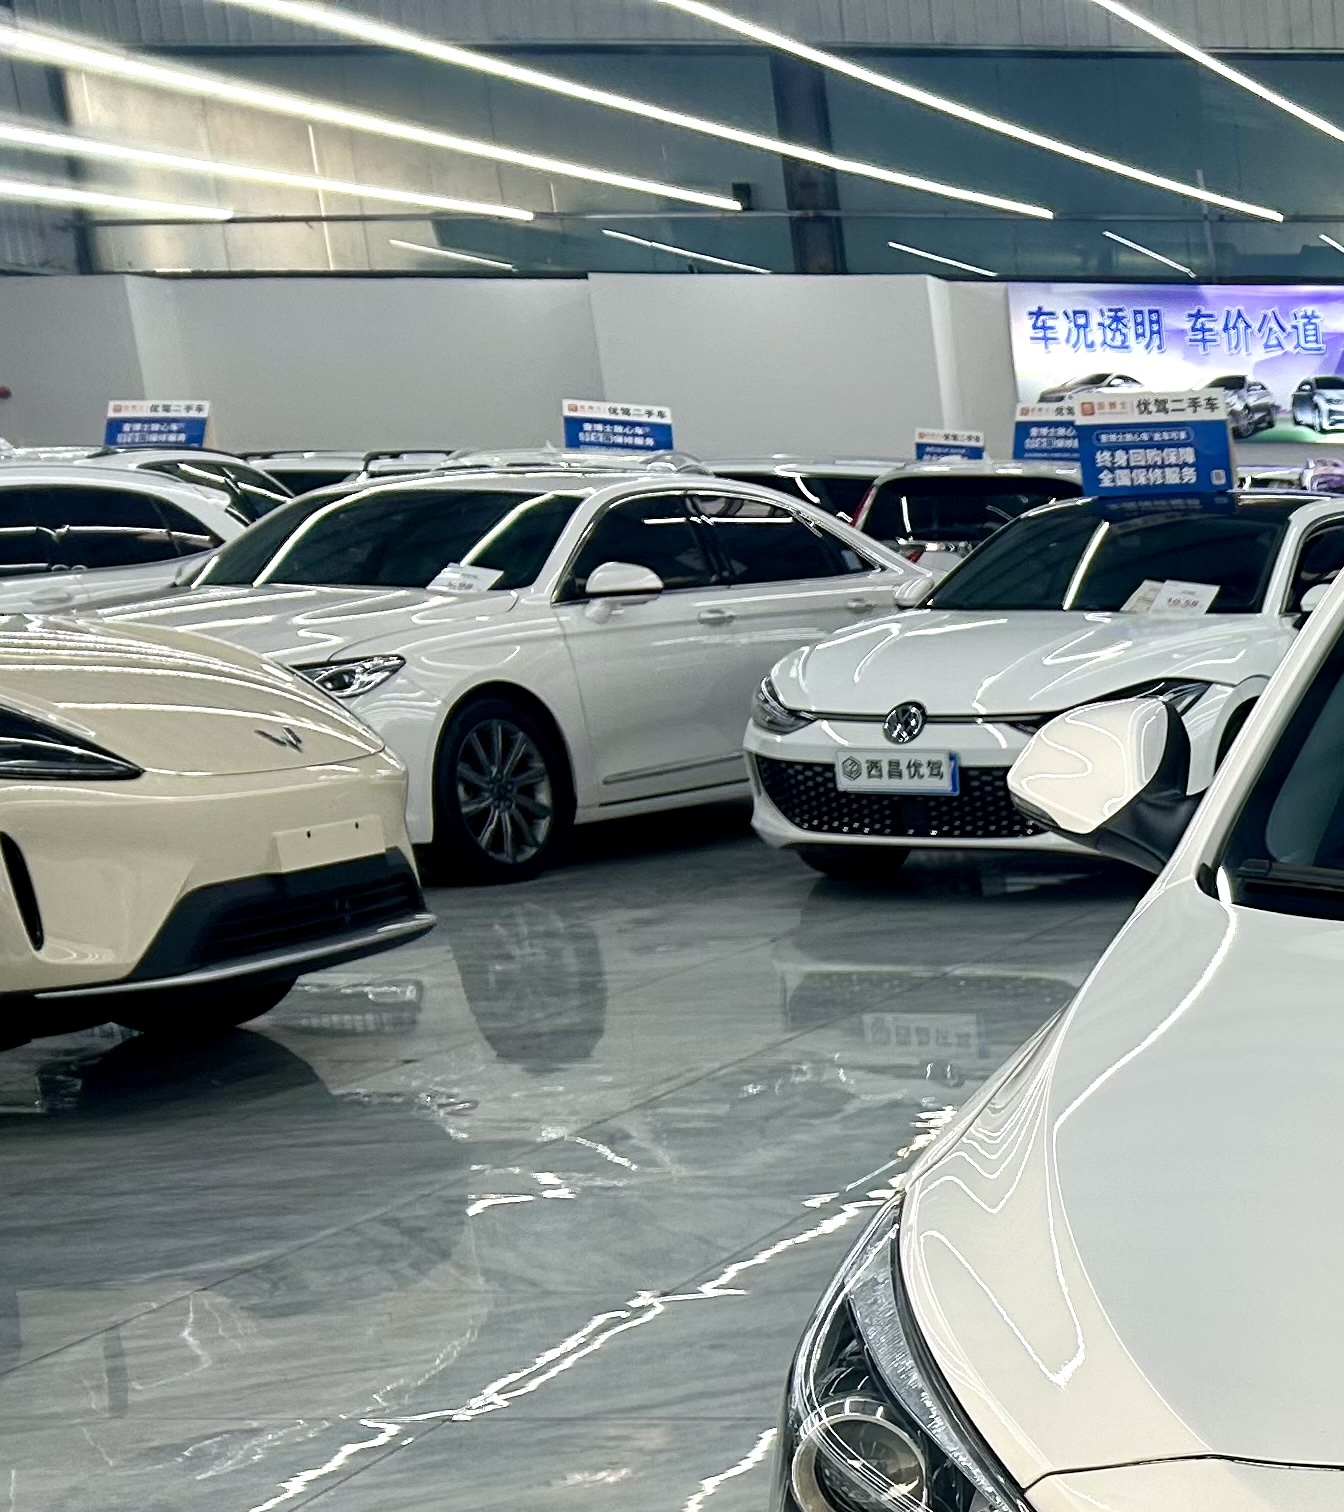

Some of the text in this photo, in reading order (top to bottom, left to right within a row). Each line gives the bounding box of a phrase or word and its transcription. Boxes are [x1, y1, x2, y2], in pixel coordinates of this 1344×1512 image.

[1028, 306, 1165, 351] 车况透明
[1187, 308, 1324, 354] 车价公道
[1136, 396, 1220, 415] 优驾二手车
[1095, 447, 1196, 467] 终身回购保障
[1098, 466, 1197, 487] 全国保修服务
[865, 758, 944, 781] 西昌优驾
